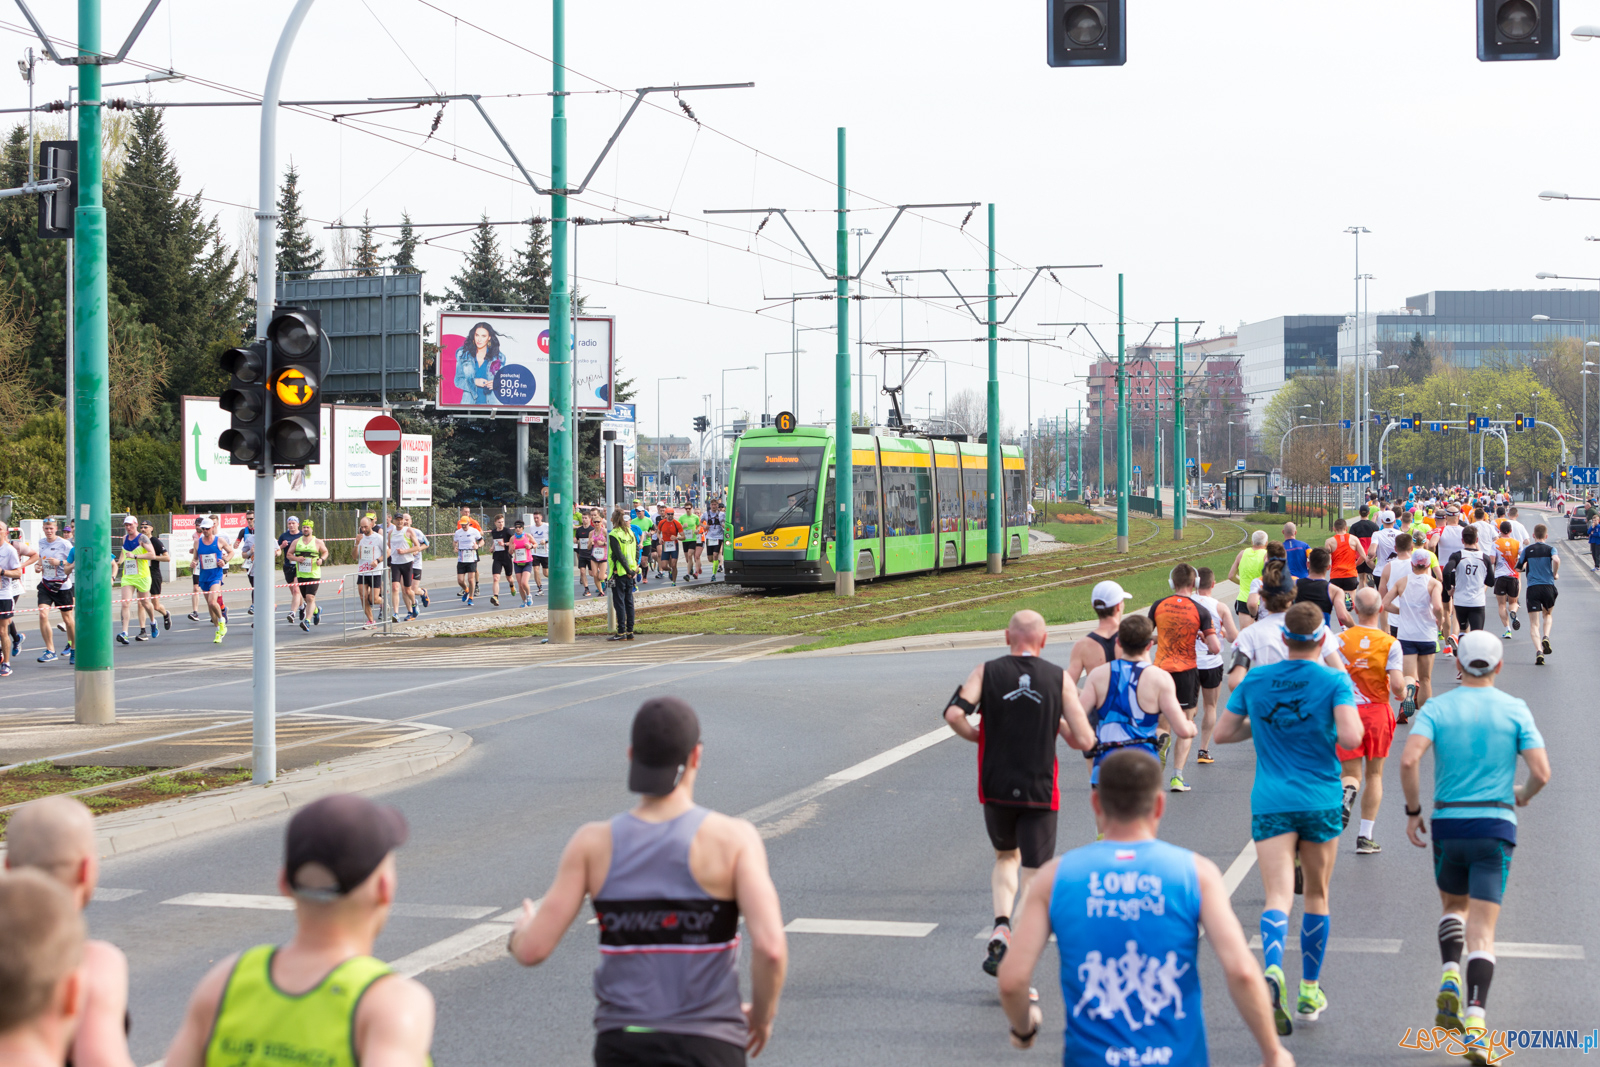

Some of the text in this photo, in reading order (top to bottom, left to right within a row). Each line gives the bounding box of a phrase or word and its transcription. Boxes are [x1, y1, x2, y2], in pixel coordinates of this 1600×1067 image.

[578, 339, 597, 347] radio
[500, 379, 519, 389] 90,6
[500, 388, 519, 398] 99,4
[524, 415, 541, 423] ams
[780, 414, 790, 430] 6
[402, 440, 431, 452] WYKŁADZINY
[1465, 564, 1479, 576] 67
